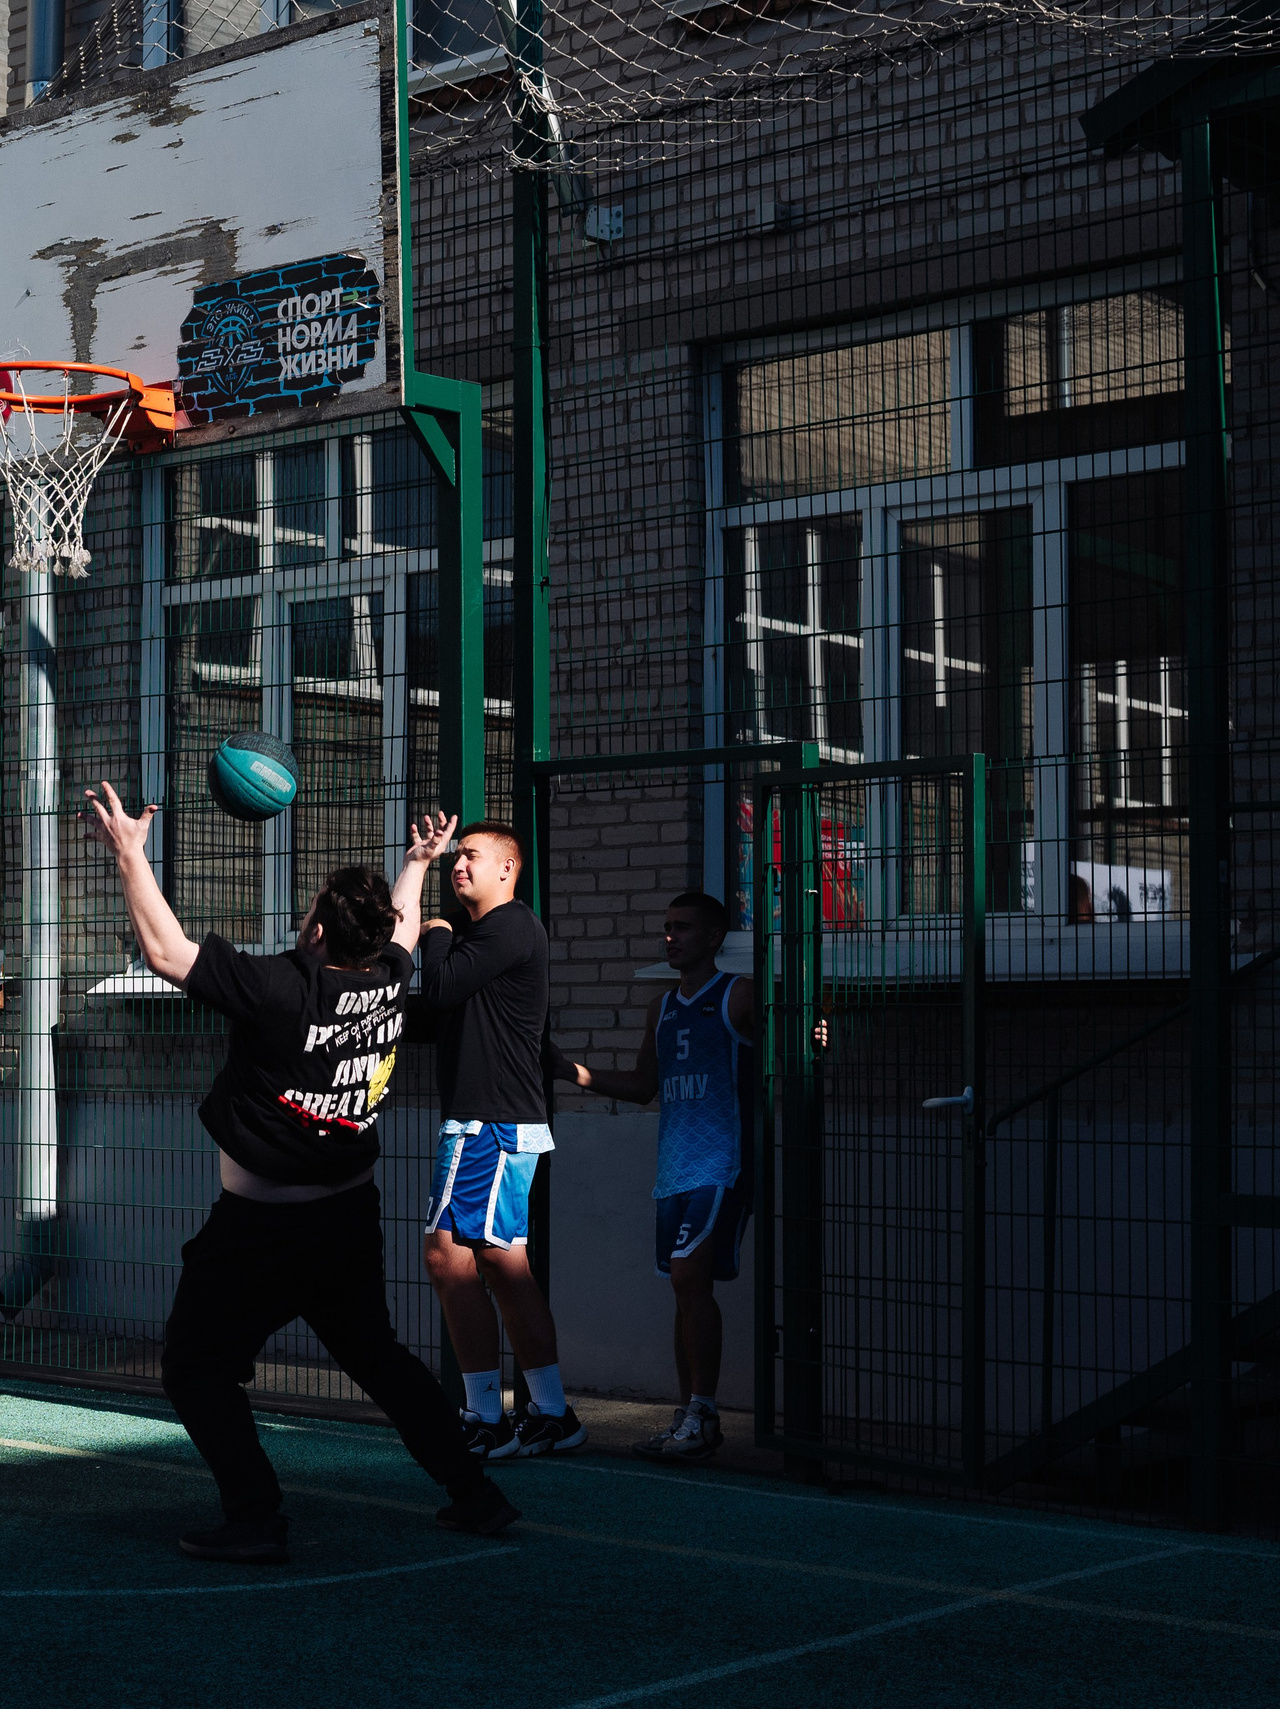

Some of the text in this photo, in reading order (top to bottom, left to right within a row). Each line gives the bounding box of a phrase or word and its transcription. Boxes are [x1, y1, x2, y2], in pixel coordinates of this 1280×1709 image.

[277, 287, 344, 323] СПОРТ
[277, 314, 358, 353] НОРМА
[278, 342, 358, 381] ЖИЗНИ
[334, 1030, 349, 1048] KEEP
[676, 1028, 691, 1061] 5
[662, 1073, 709, 1104] АГМУ
[676, 1223, 692, 1246] 5
